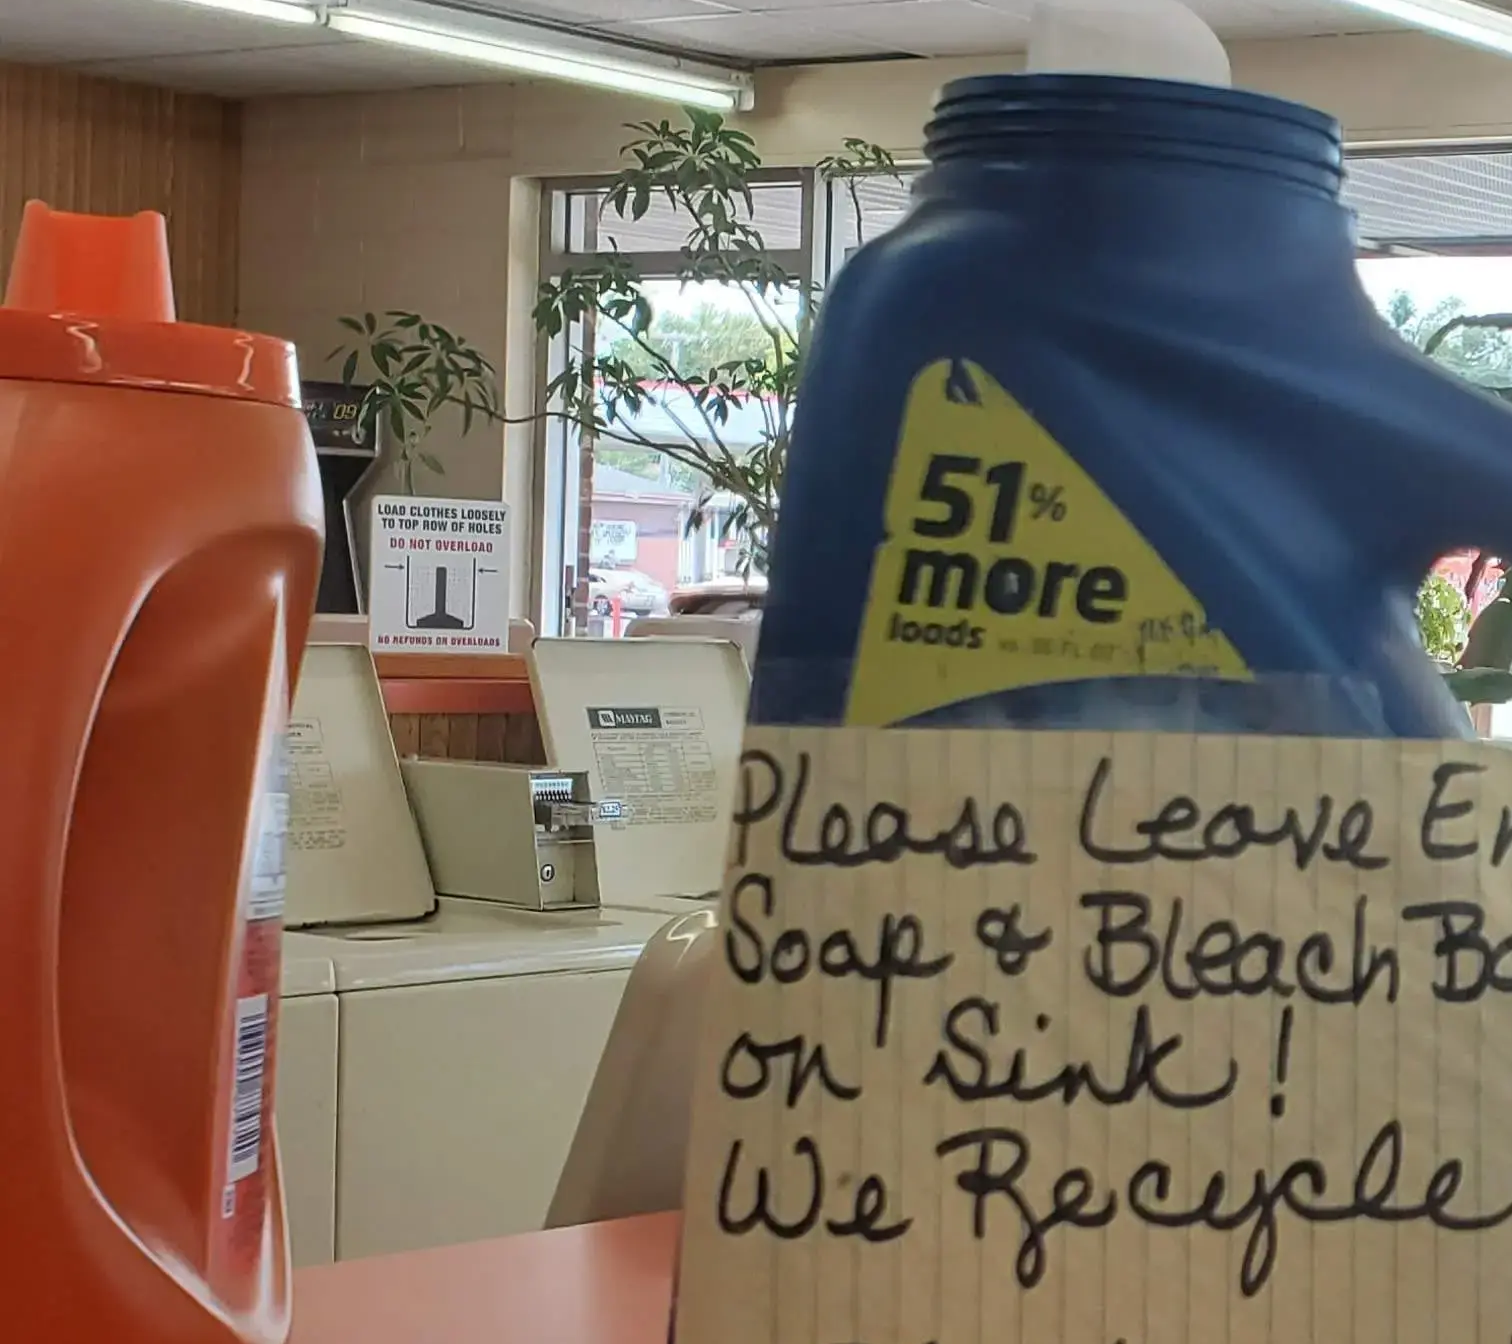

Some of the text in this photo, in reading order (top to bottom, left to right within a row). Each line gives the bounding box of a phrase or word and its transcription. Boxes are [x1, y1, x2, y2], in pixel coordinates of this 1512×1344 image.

[378, 504, 507, 522] LOAD CLOTHES LOOSELY
[382, 518, 502, 535] TO TOP ROW OF HOLES
[390, 537, 493, 553] DO NOT OVERLOAD
[897, 548, 1130, 624] more
[392, 635, 433, 645] REFUNDS
[451, 637, 500, 647] OVERLOADS
[887, 612, 987, 650] loads
[615, 714, 653, 725] MAYTAG
[733, 750, 1038, 868] Please
[1080, 758, 1390, 870] Leave
[726, 873, 954, 1048] Soap
[976, 903, 1053, 975] &
[1079, 891, 1400, 1006] Bleach
[722, 1032, 862, 1109] on
[718, 1136, 914, 1242] We
